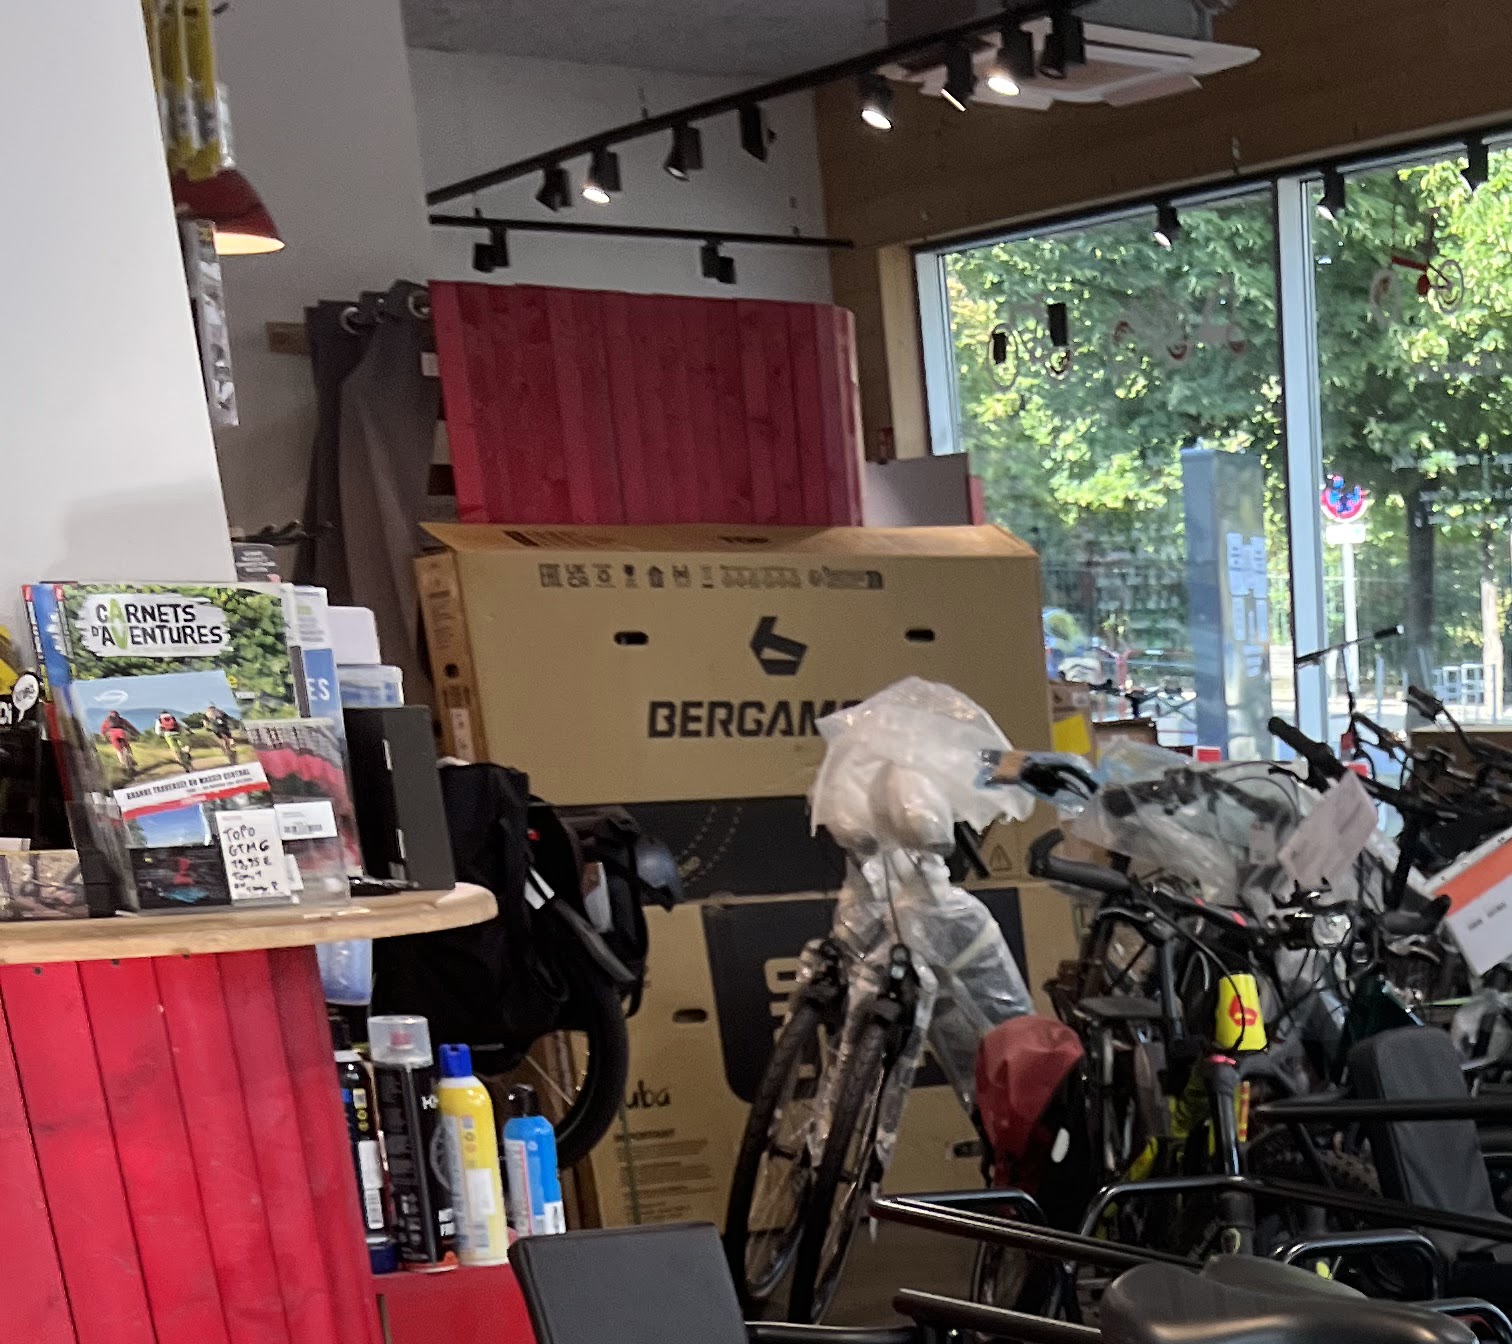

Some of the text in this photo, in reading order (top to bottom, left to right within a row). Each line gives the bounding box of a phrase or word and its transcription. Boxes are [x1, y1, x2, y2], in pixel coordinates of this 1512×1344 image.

[95, 598, 196, 624] CARNETS
[91, 624, 223, 650] D'AVENTURES
[648, 700, 862, 738] BERGAM
[624, 1079, 671, 1108] uba
